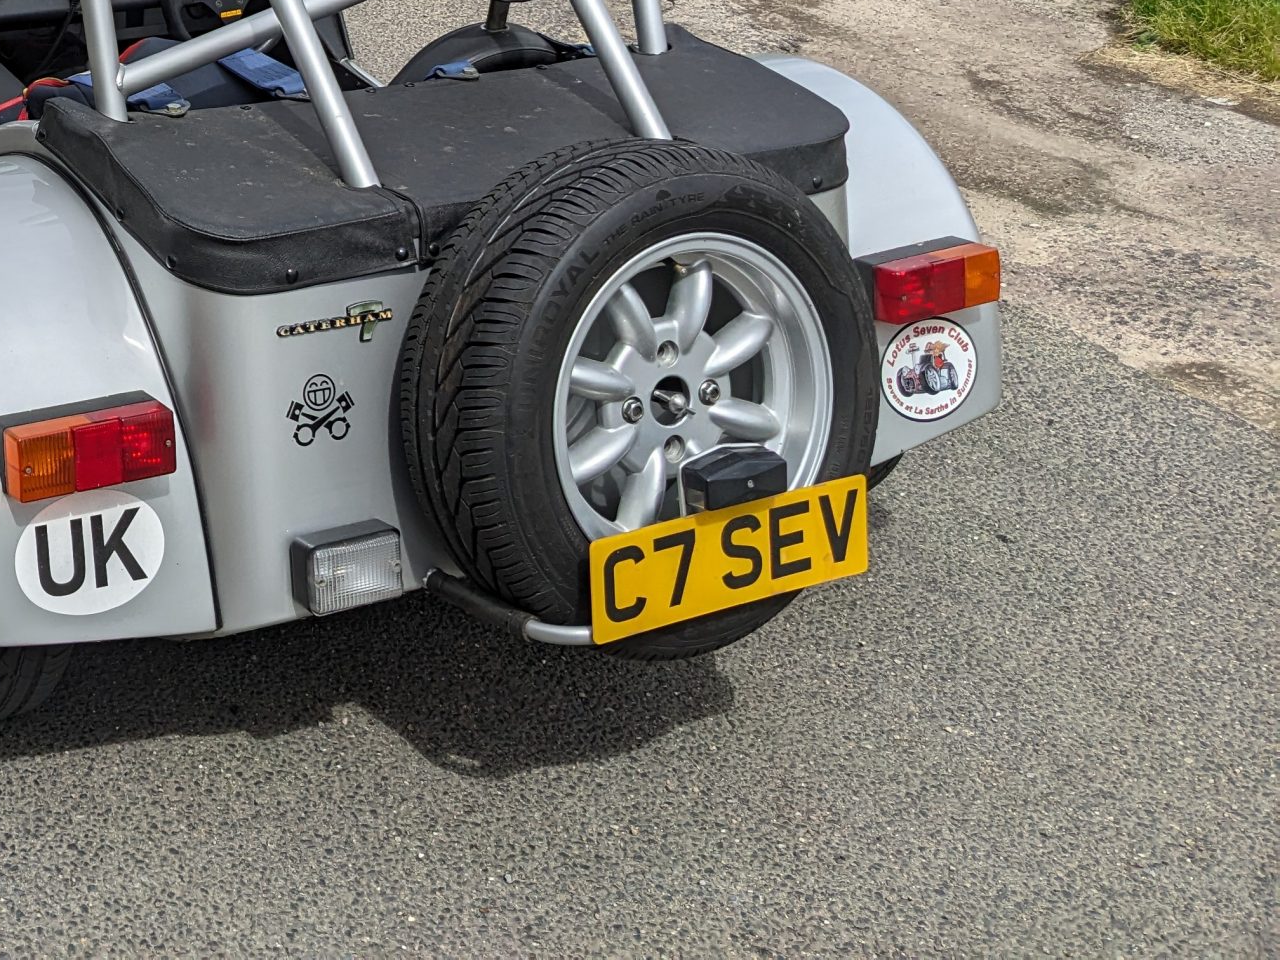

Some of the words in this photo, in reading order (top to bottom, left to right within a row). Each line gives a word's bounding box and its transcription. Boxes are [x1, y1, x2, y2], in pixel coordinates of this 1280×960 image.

[604, 224, 628, 244] THE
[631, 203, 664, 223] RAIN
[670, 192, 705, 208] TYRE
[277, 309, 393, 338] CATERHAM
[887, 334, 911, 367] Lotus
[913, 325, 946, 338] Seven
[948, 327, 969, 352] Club
[886, 377, 904, 407] Sevens
[905, 404, 913, 412] at
[914, 406, 923, 415] La
[925, 403, 949, 415] Sarthe
[950, 396, 957, 405] in
[957, 359, 973, 397] Summer
[34, 506, 148, 597] UK
[603, 528, 695, 623] C7
[721, 489, 858, 590] SEV
